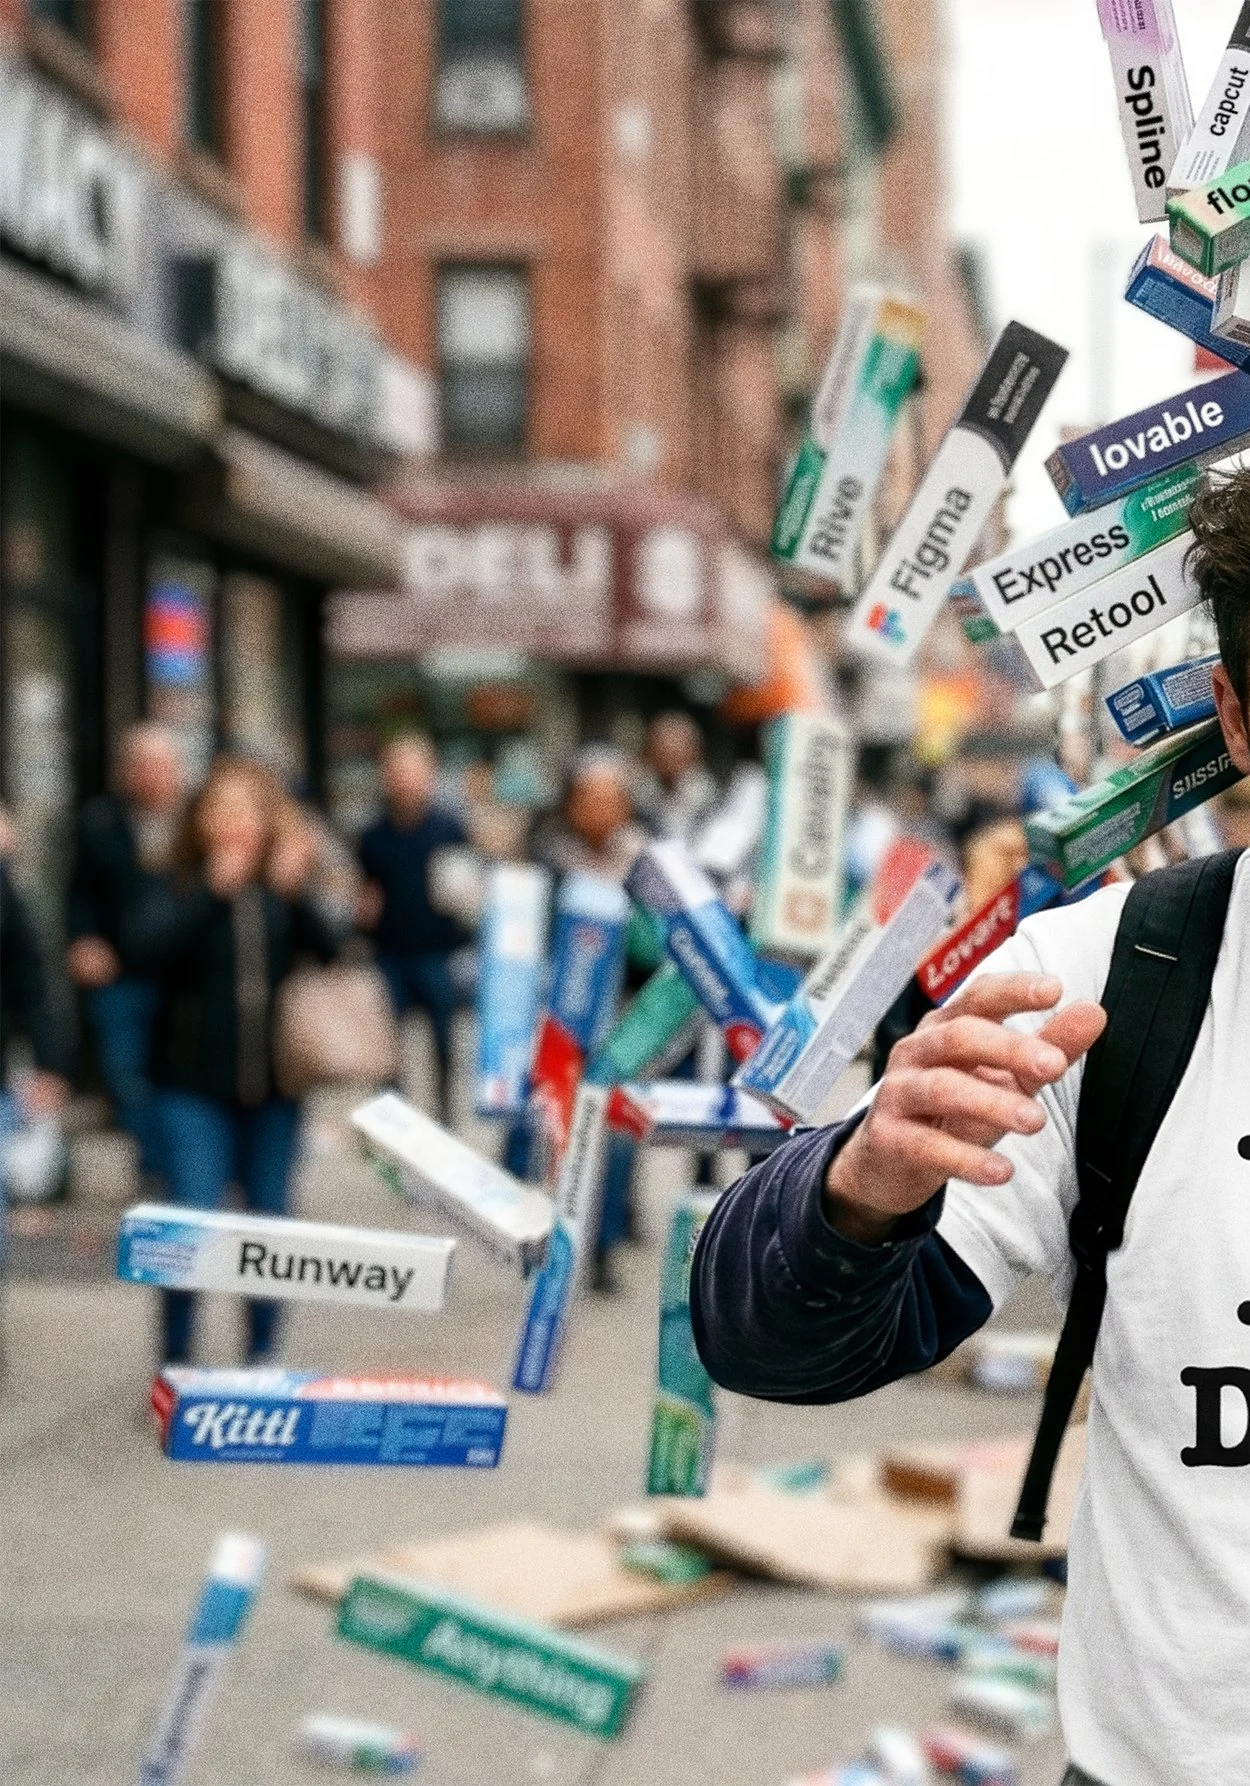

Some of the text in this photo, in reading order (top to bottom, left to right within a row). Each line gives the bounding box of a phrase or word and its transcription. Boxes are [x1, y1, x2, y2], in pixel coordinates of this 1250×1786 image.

[1125, 64, 1166, 189] Spline
[1210, 67, 1250, 137] capcut
[1089, 400, 1224, 477] lovable
[808, 476, 863, 562] Rive
[889, 485, 971, 600] Figma
[991, 524, 1131, 606] Express
[1040, 575, 1167, 665] Retool
[922, 896, 1014, 990] Lovart
[237, 1240, 415, 1301] Runway
[183, 1402, 299, 1450] Kittl
